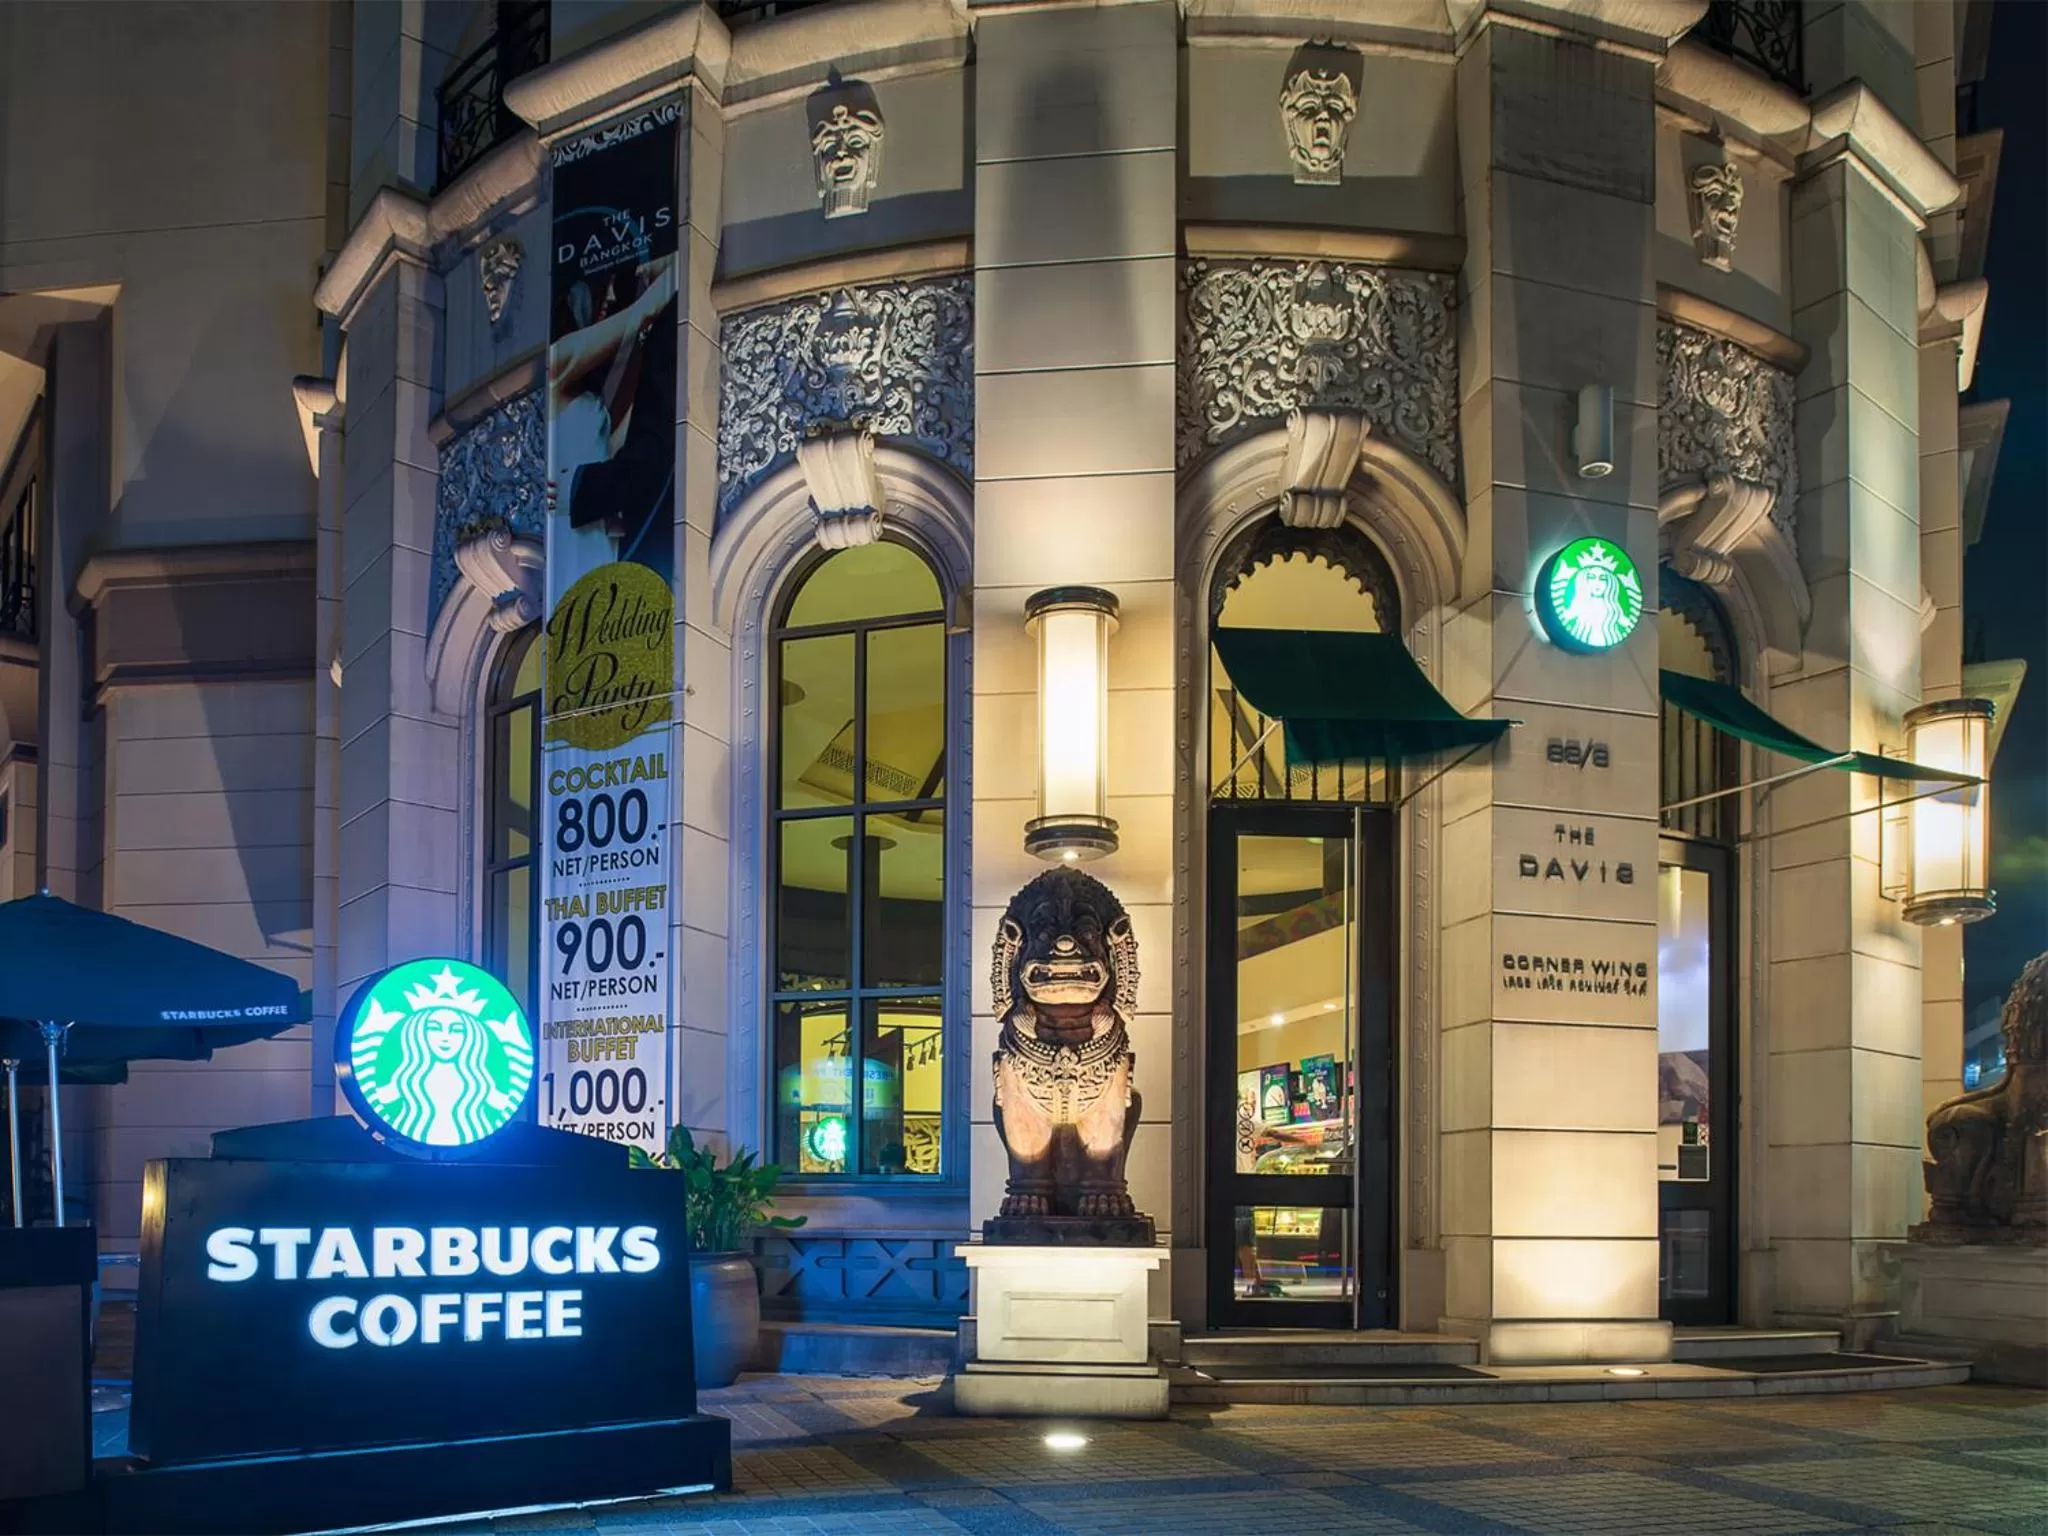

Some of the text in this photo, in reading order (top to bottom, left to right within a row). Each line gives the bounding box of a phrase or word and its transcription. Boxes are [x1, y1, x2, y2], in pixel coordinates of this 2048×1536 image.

[603, 208, 630, 226] THE
[559, 207, 671, 263] DAVIS
[580, 233, 653, 268] BANGKOK
[546, 582, 670, 663] Wedding
[552, 654, 655, 731] Party
[548, 753, 668, 796] COCKTAIL
[1554, 824, 1594, 846] THE
[552, 847, 659, 877] NET/PERSON
[545, 884, 667, 921] THAI BUFFET
[1503, 954, 1647, 978] CORNER WING
[550, 974, 658, 1001] NET/PERSON
[161, 1005, 288, 1020] STARBUCKS COFFEE
[543, 1014, 664, 1040] INTERNATIONAL
[567, 1036, 638, 1063] BUFFET
[206, 1226, 661, 1282] STARBUCKS
[308, 1290, 583, 1349] COFFEE
